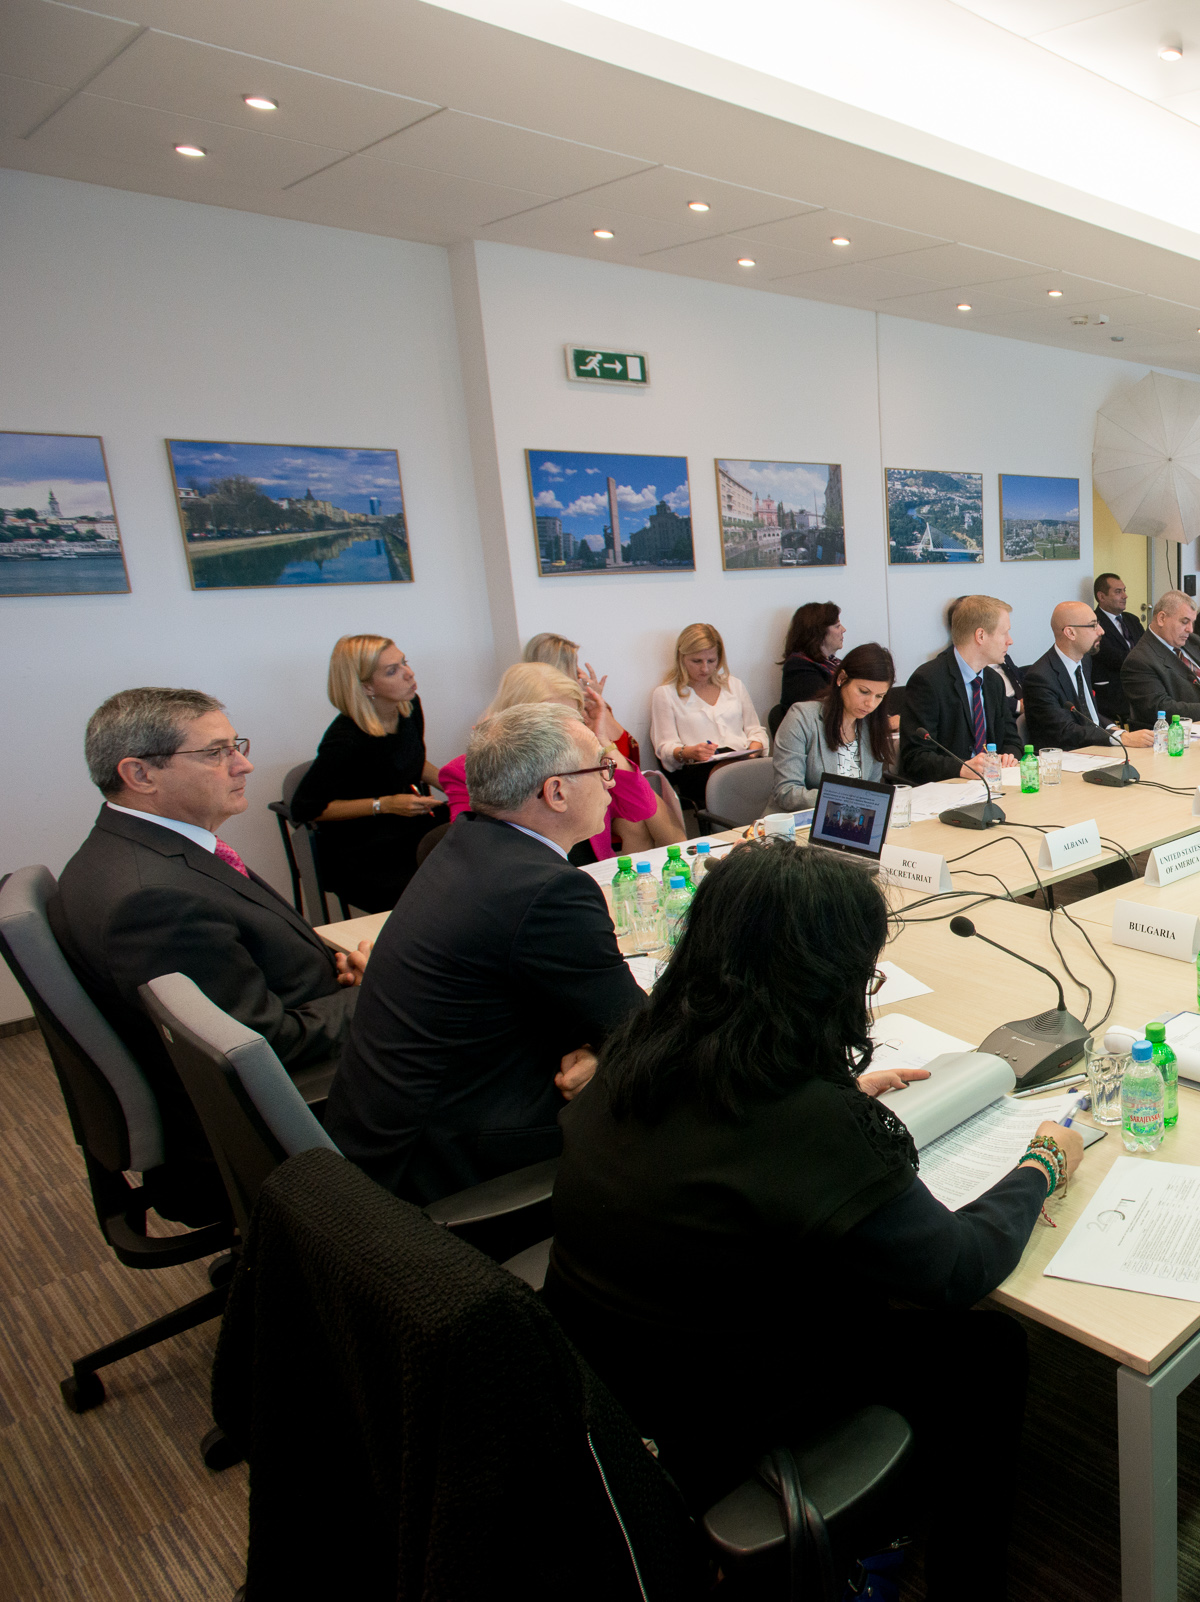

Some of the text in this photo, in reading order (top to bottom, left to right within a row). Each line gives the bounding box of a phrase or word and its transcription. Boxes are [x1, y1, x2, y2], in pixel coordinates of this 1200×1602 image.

[1063, 837, 1089, 851] ALBANIA
[902, 859, 917, 869] RCC
[1159, 851, 1182, 865] UNITED
[1165, 856, 1200, 875] OF AMERICA
[885, 867, 932, 884] SECRETARIAT
[1128, 921, 1176, 940] BULGARIA
[1129, 1113, 1161, 1124] SARAJEVSKA
